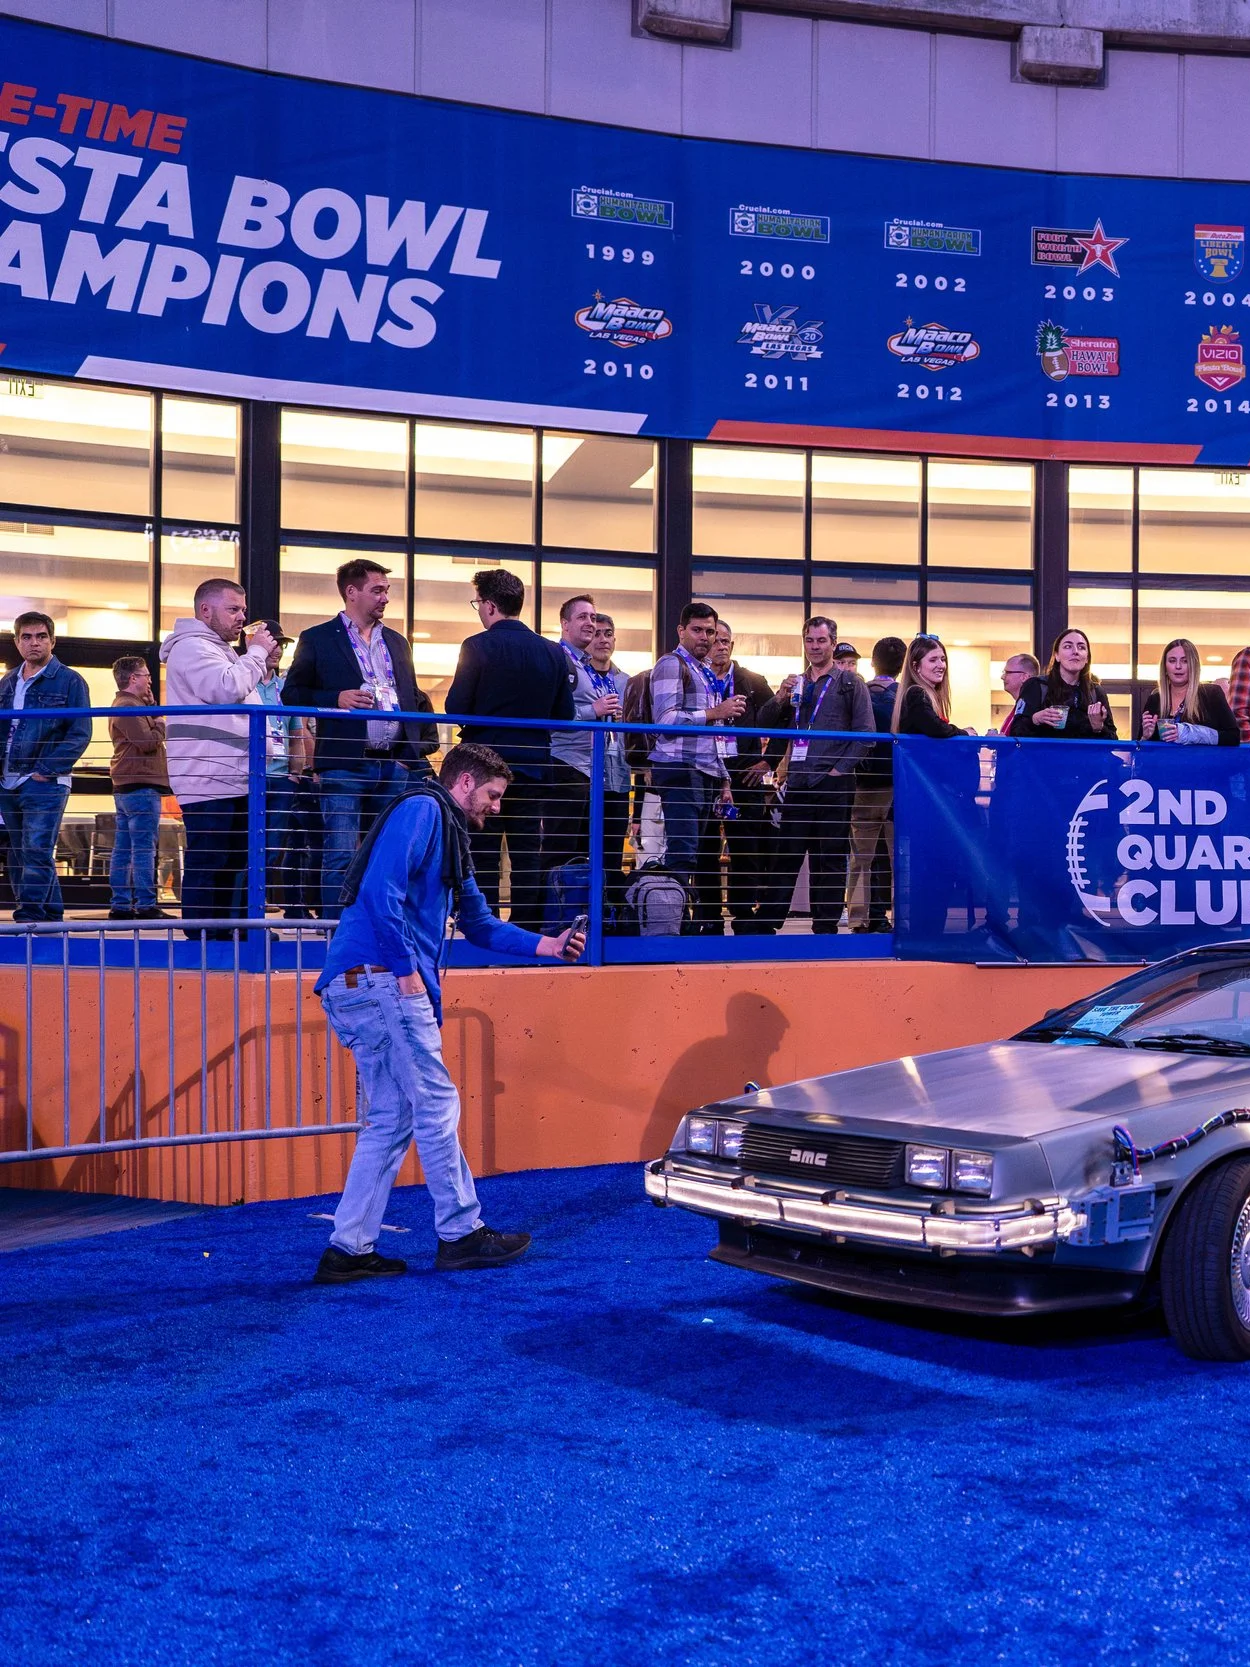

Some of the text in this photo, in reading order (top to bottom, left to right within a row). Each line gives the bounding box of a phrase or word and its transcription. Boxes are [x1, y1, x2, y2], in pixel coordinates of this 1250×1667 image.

[581, 186, 633, 198] Crucial.com
[0, 131, 501, 279] STA BOWL
[599, 196, 665, 212] HUMANITARIAN
[739, 204, 791, 215] Crucial.com
[599, 205, 670, 226] BOWL
[757, 214, 821, 227] HUMANITARIAN
[893, 218, 943, 228] Crucial.com
[757, 223, 827, 240] BOWL
[911, 227, 972, 240] HUMANITARIAN
[911, 236, 977, 253] BOWL
[1200, 240, 1239, 249] LIBERTY
[586, 244, 655, 265] 1999
[1037, 252, 1073, 262] BOWL
[1205, 247, 1234, 259] BOWL
[740, 260, 815, 280] 2000
[896, 273, 966, 292] 2002
[1044, 285, 1114, 301] 2003
[613, 333, 647, 344] VEGAS
[804, 332, 816, 341] 20
[1070, 339, 1116, 348] Sheraton
[784, 344, 813, 352] VEGAS
[1202, 349, 1239, 360] VIZIO
[923, 357, 955, 366] VEGAS
[1076, 361, 1108, 374] BOWL
[583, 359, 654, 379] 2010
[745, 373, 808, 391] 2011
[897, 383, 962, 401] 2012
[1046, 393, 1110, 409] 2013
[1187, 398, 1250, 414] 2014
[1118, 779, 1228, 826] 2ND
